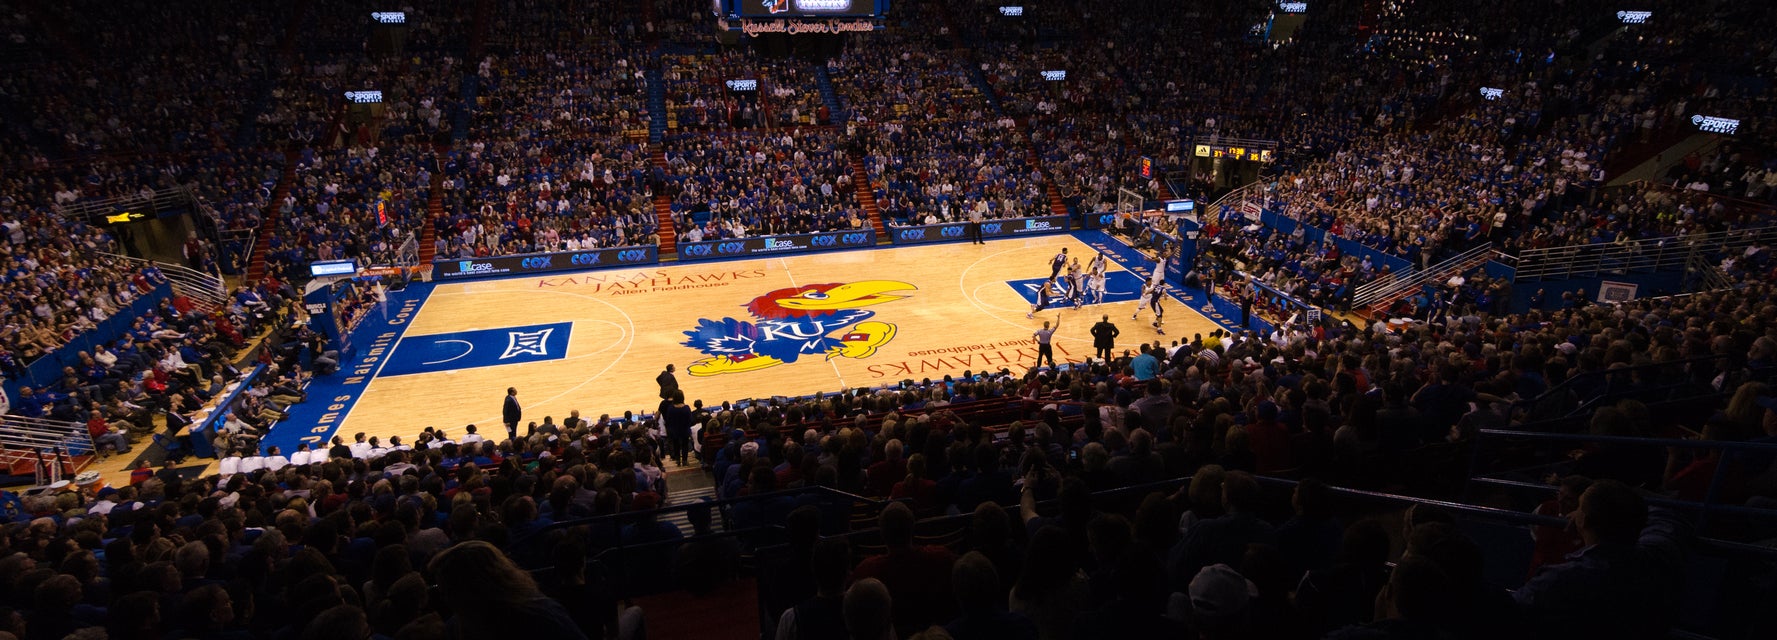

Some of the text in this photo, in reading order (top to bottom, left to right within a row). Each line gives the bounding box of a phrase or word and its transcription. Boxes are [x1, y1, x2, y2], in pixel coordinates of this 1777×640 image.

[742, 18, 873, 37] Russell Stover Candies
[1702, 119, 1739, 129] SPORTS
[901, 228, 925, 240] COX
[941, 225, 965, 237] COX
[685, 243, 712, 256] COX
[718, 241, 746, 254] COX
[811, 234, 837, 246] COX
[842, 232, 868, 245] COX
[1091, 242, 1128, 262] James
[522, 256, 552, 269] COX
[571, 252, 600, 265] COX
[618, 249, 647, 262] COX
[538, 269, 667, 288] KANSAS
[593, 269, 767, 293] JAYHAWKS
[611, 281, 729, 296] Allen Fieldhouse
[758, 321, 824, 341] KU
[908, 343, 996, 357] Fieldhouse
[301, 298, 420, 443] James Naismith Court
